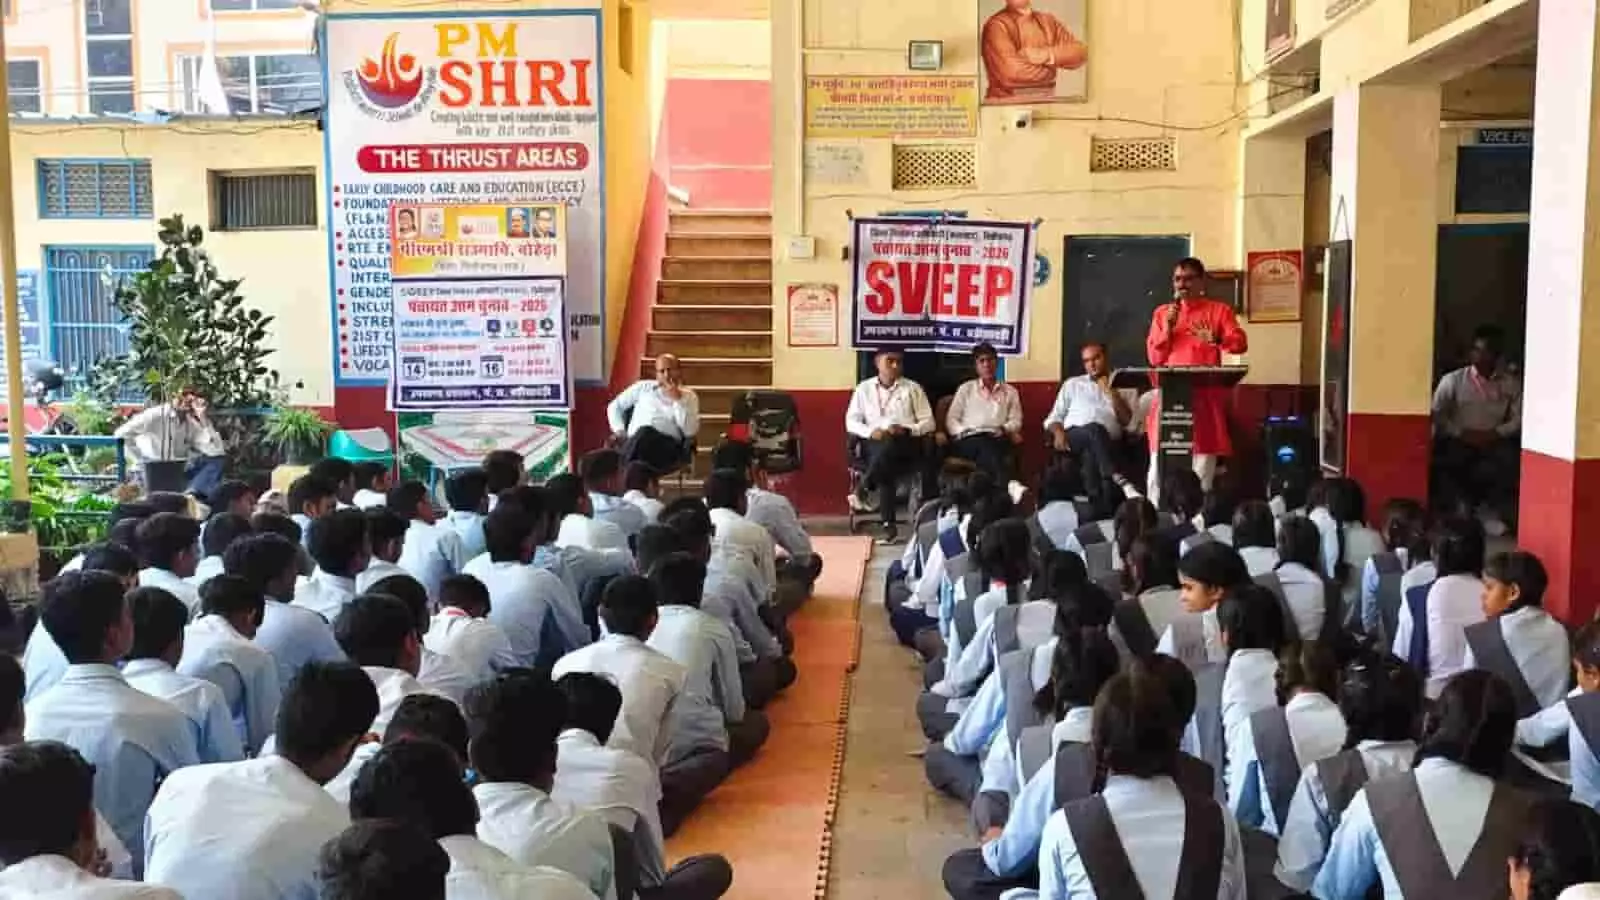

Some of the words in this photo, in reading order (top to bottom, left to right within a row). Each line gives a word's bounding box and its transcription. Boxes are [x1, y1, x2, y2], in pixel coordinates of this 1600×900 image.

[433, 22, 519, 57] PM
[439, 60, 592, 107] SHRI
[373, 149, 421, 169] THE
[428, 148, 512, 169] THRUST
[516, 147, 578, 168] AREAS
[343, 183, 370, 194] EARLY
[373, 183, 426, 194] CHILDHOOD
[430, 182, 457, 194] CARE
[460, 182, 481, 193] AND
[484, 181, 543, 194] EDUCATION
[348, 243, 370, 254] RTE
[865, 261, 1013, 317] SVEEP
[352, 331, 380, 342] 21ST
[406, 364, 421, 376] 14
